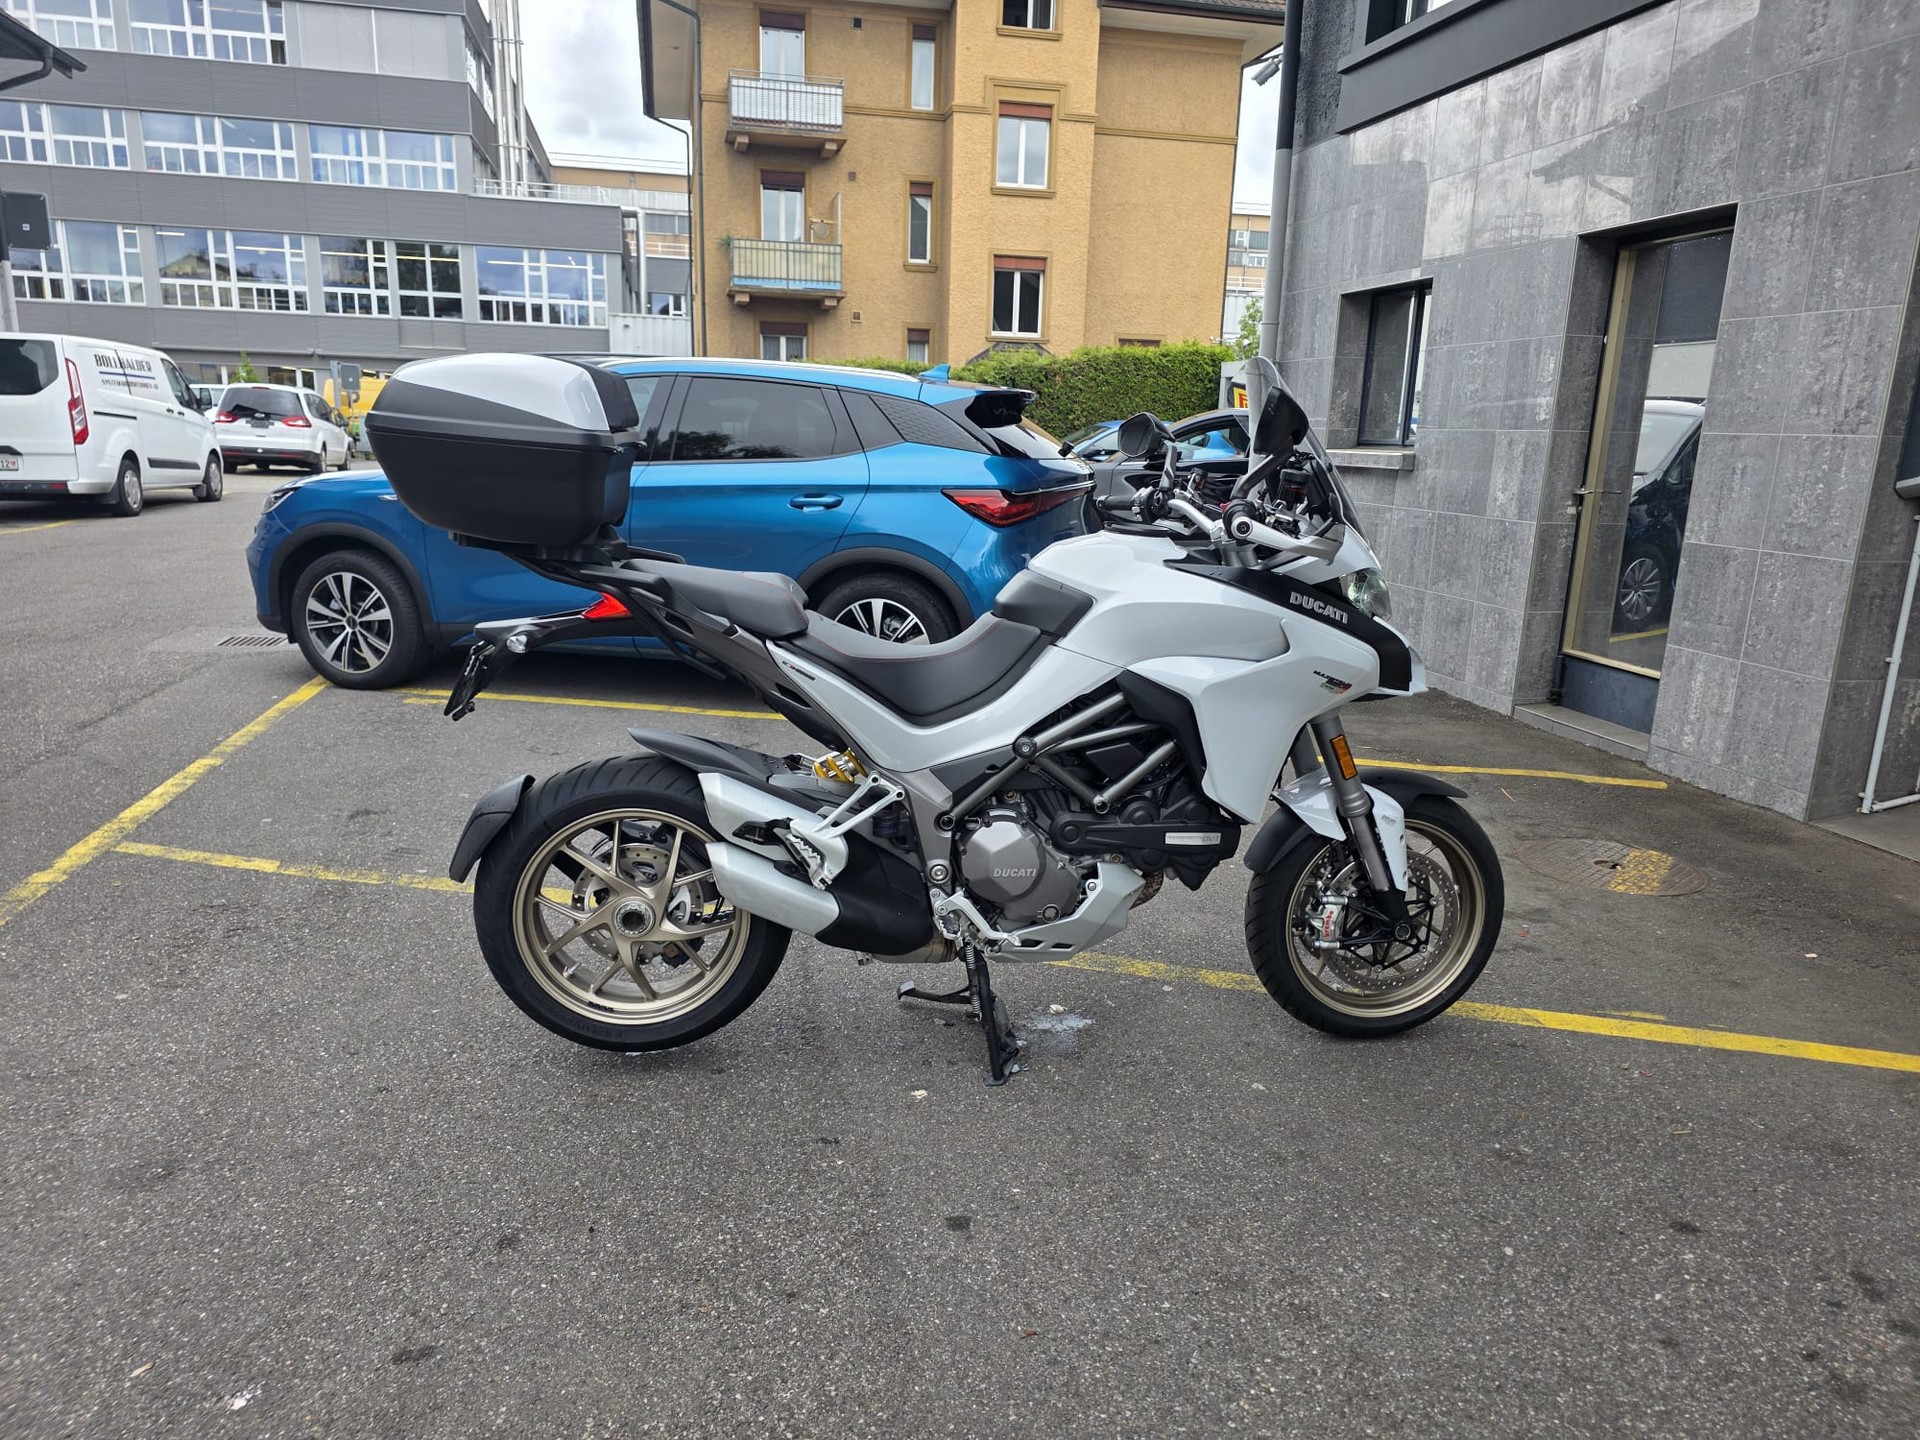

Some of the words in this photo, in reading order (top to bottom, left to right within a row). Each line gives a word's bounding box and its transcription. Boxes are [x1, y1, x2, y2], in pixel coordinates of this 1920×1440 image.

[94, 354, 152, 372] BOLLHALDER
[1290, 591, 1348, 624] DUCATI
[993, 868, 1037, 877] DUCATI
[1323, 910, 1334, 938] brembo
